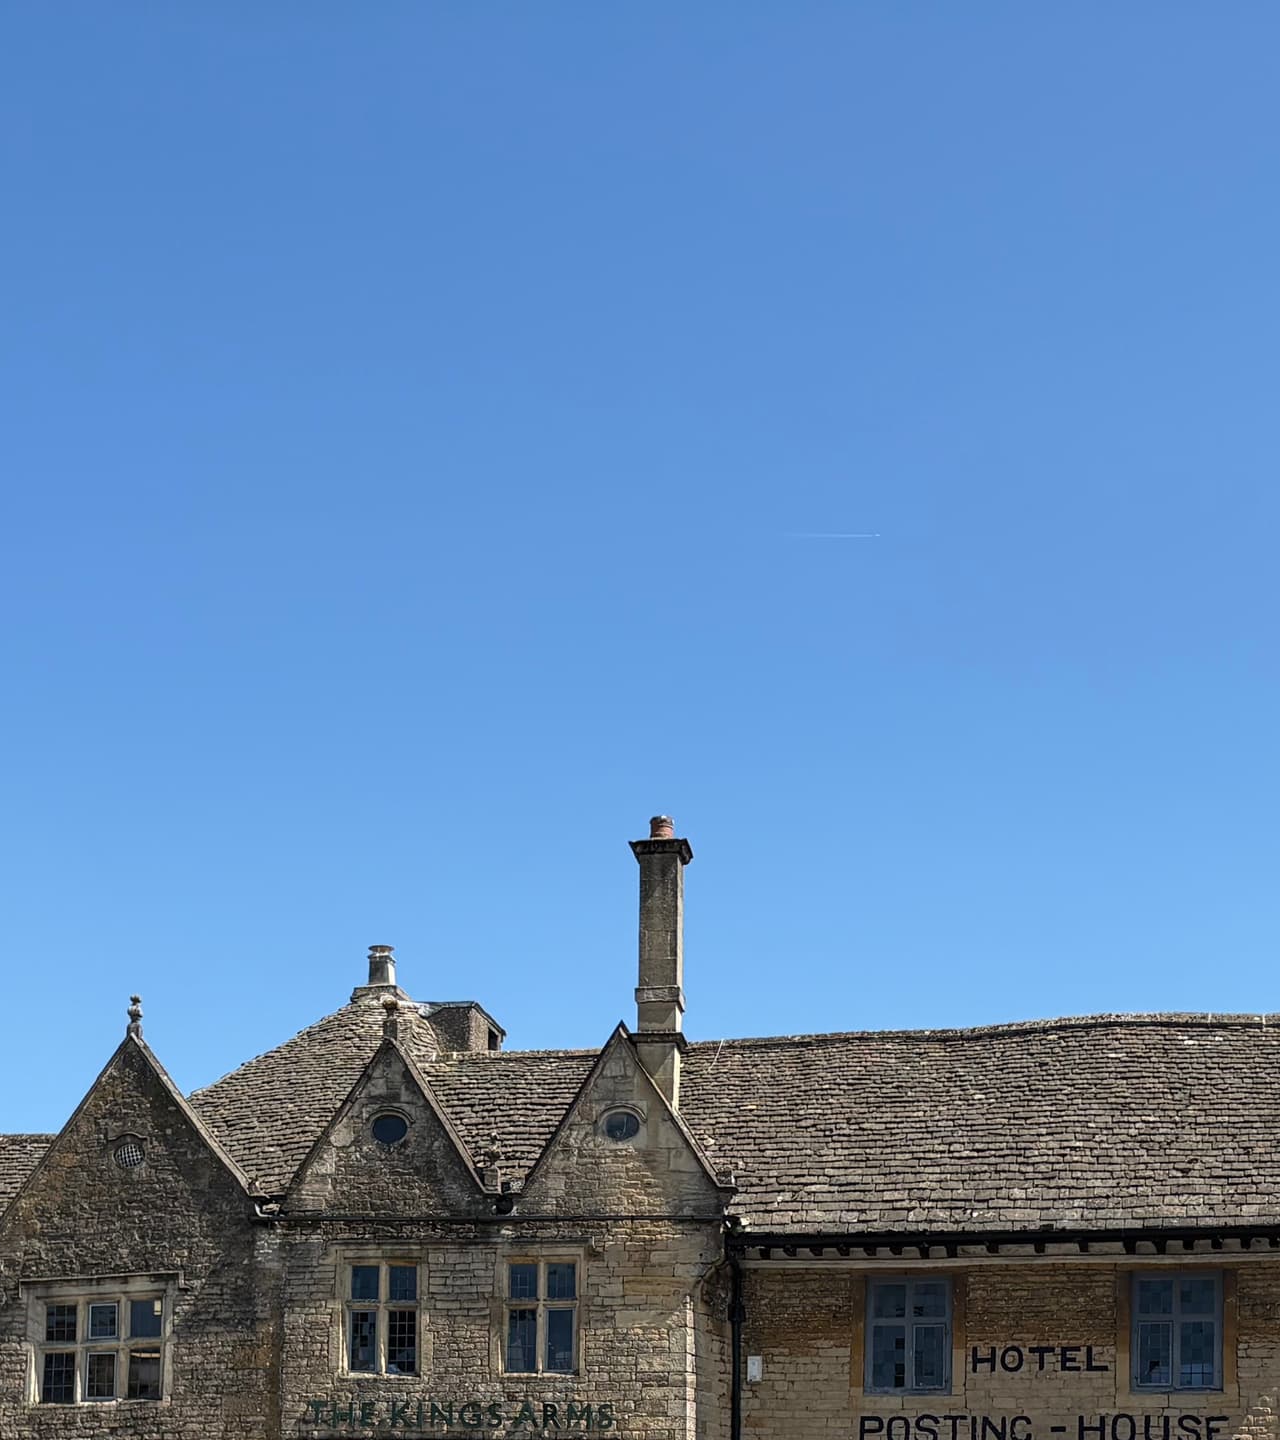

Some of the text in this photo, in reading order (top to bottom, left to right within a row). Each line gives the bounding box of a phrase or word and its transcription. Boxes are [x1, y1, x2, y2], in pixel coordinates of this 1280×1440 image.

[971, 1346, 1109, 1373] HOTEL
[306, 1400, 615, 1430] THE KINGS ARMS
